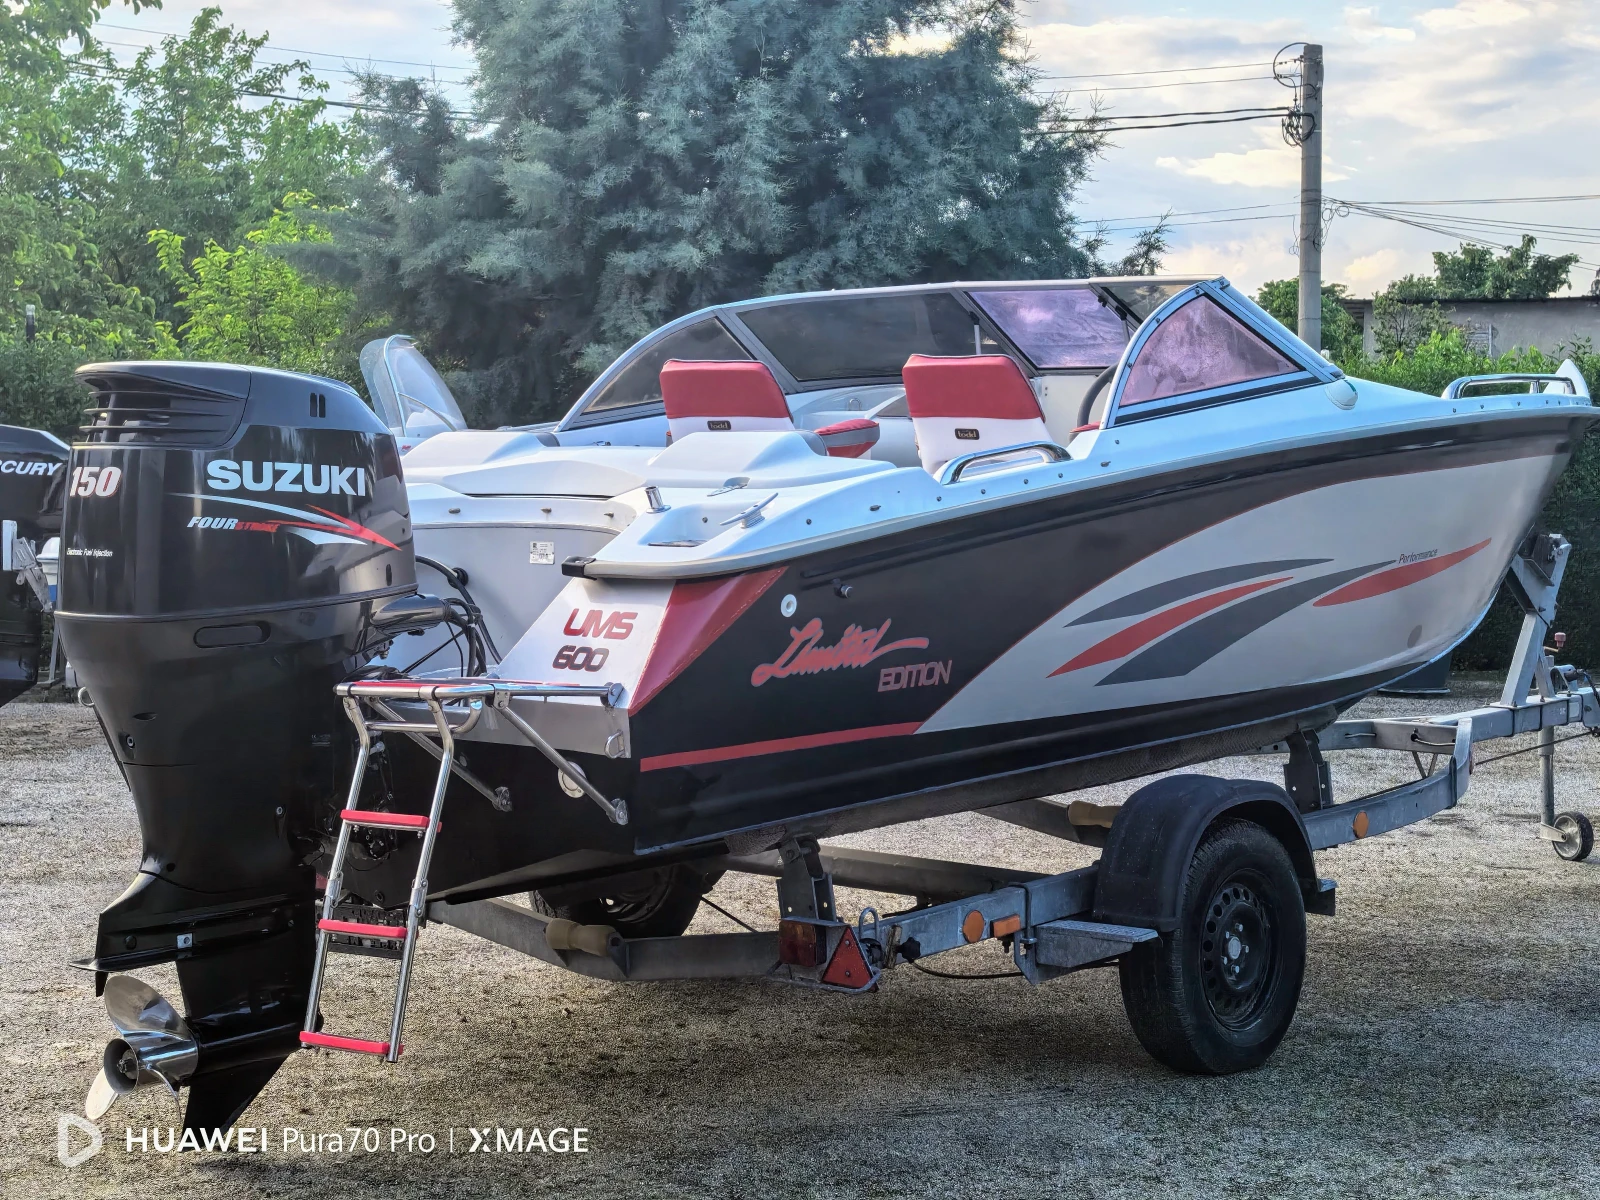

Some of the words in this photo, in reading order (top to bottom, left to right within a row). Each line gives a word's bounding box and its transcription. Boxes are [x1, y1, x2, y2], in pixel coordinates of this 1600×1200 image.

[0, 460, 62, 476] CURY
[69, 466, 122, 498] 150
[206, 459, 366, 497] SUZUKI
[563, 608, 638, 640] UMS
[552, 644, 609, 672] 600
[750, 617, 930, 688] Limited
[877, 660, 953, 693] EDITION
